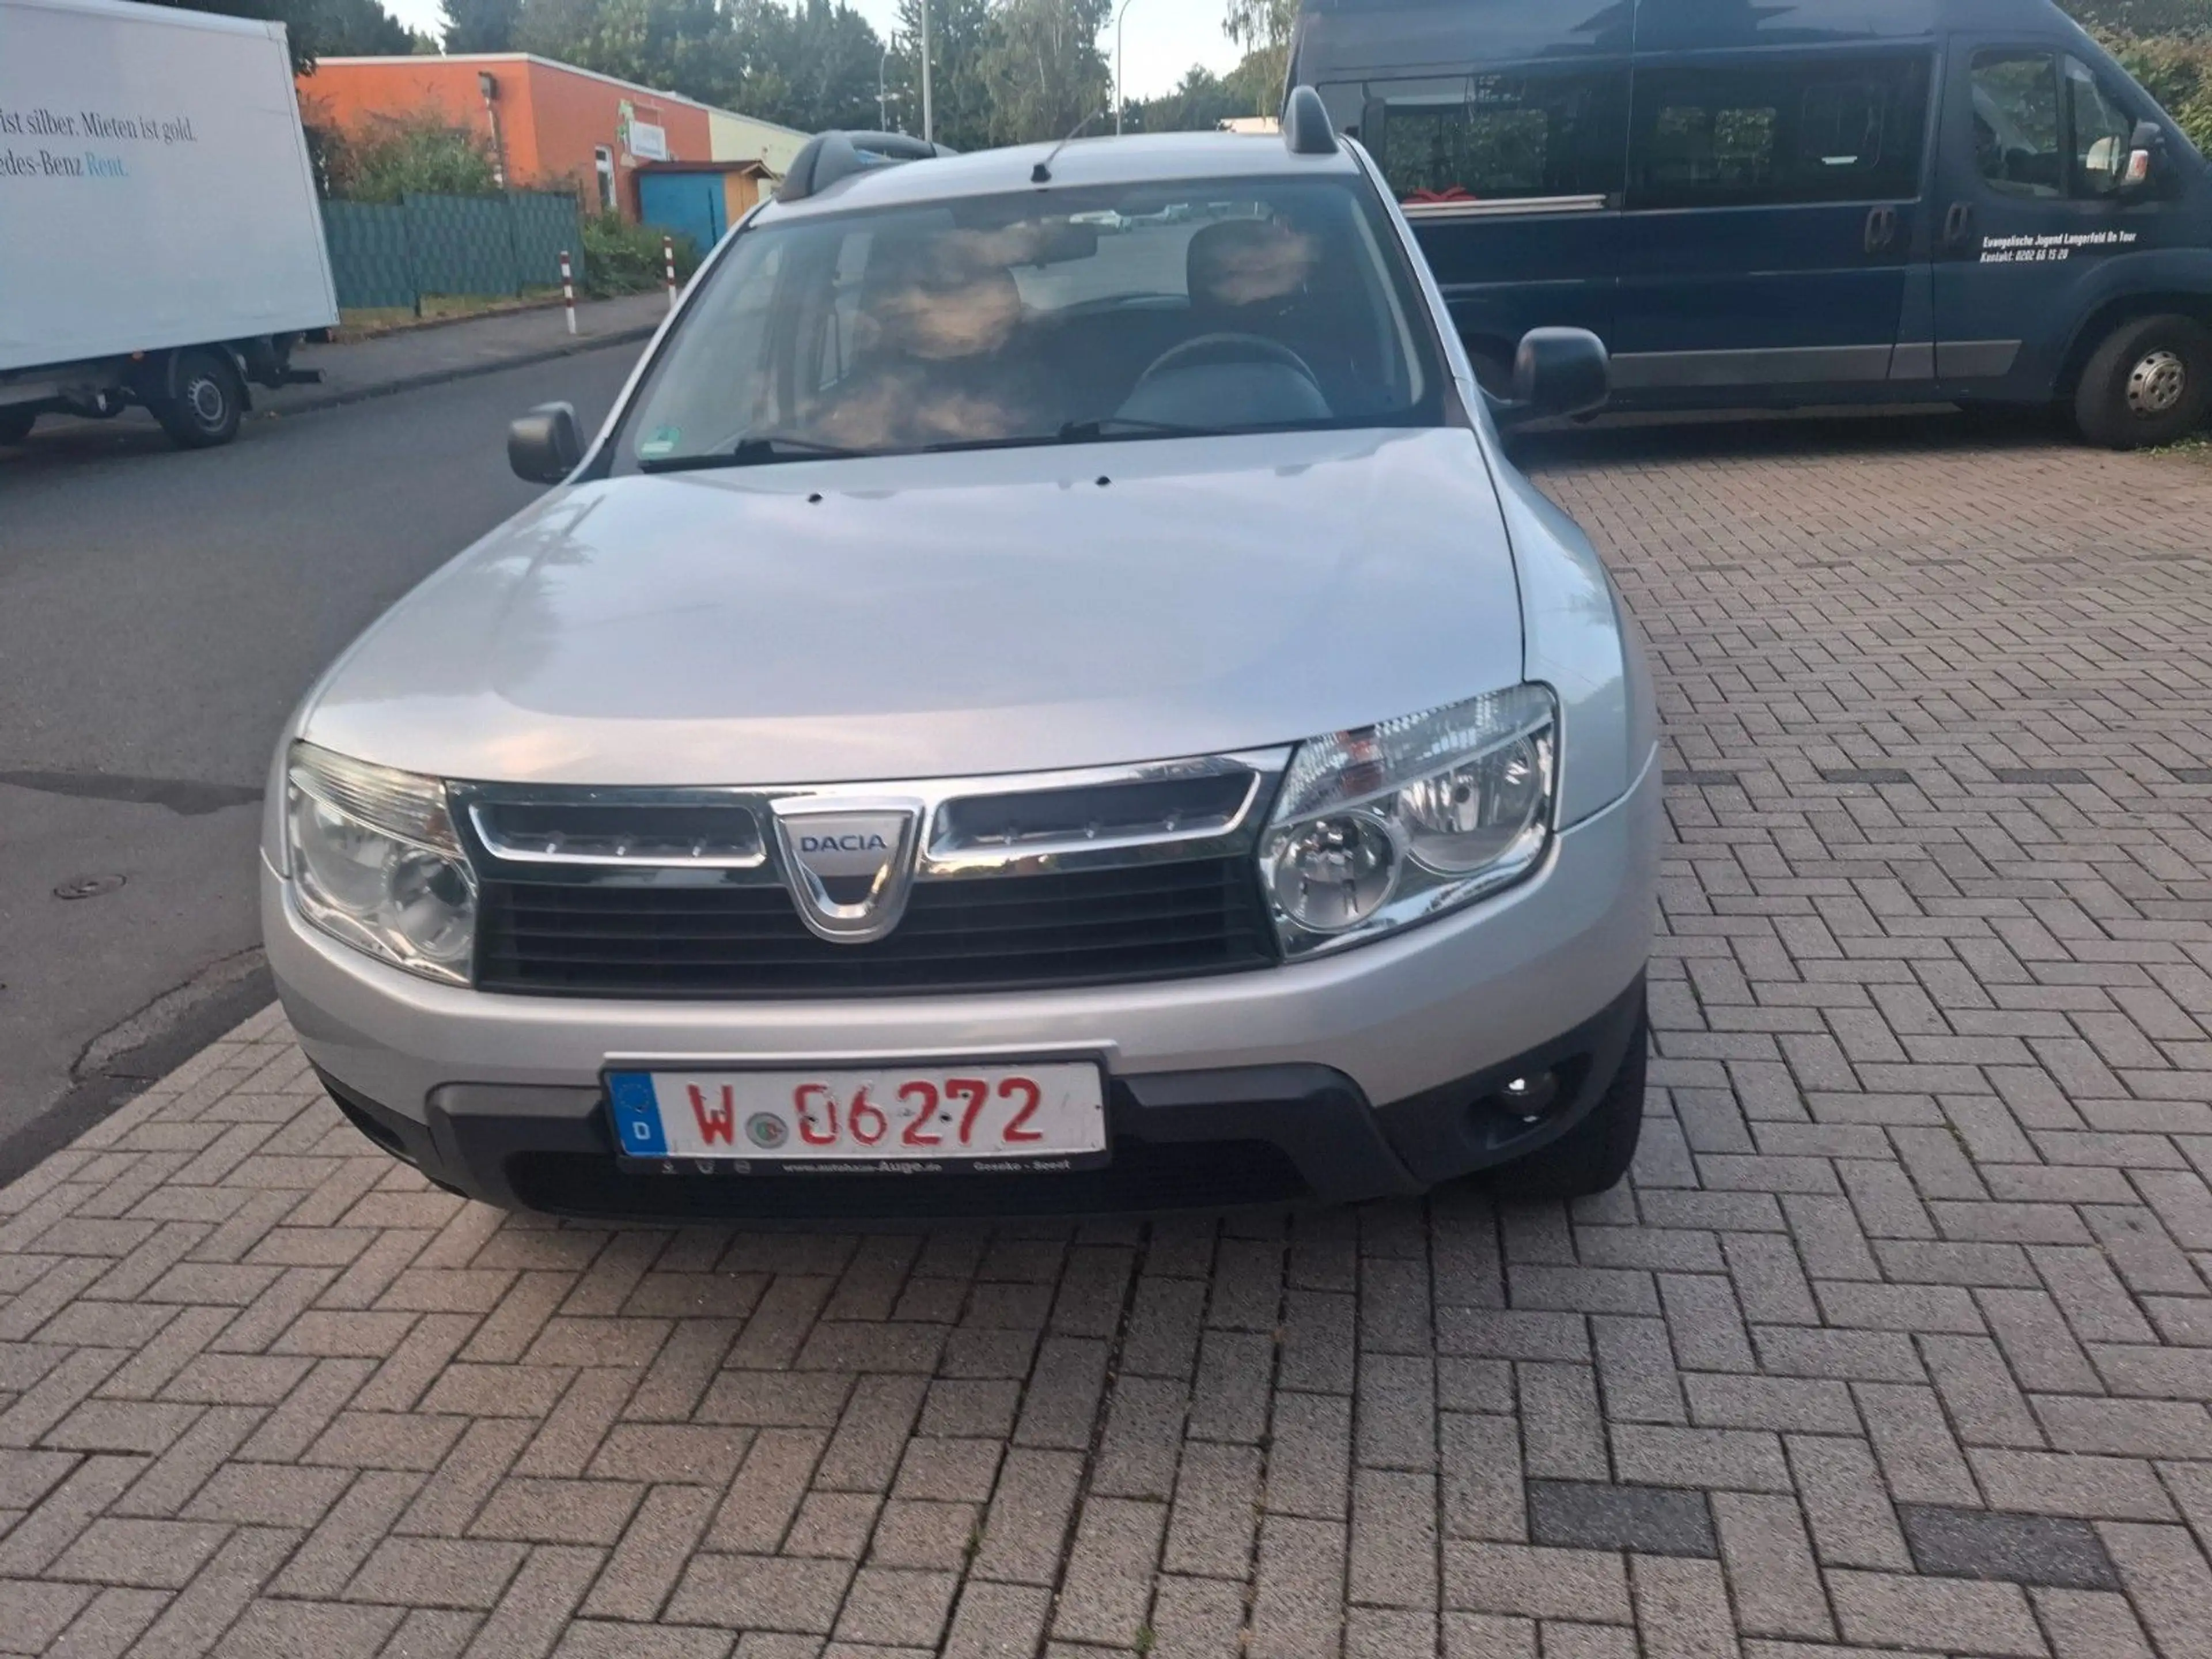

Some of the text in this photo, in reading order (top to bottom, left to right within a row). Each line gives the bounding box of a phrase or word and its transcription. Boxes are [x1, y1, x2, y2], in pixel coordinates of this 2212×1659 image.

[0, 108, 198, 145] ist silber. Mieten ist gold.
[85, 151, 130, 178] Rent.
[2035, 233, 2063, 247] Jugend
[800, 834, 888, 852] DACIA
[686, 1077, 1045, 1147] W 06272
[632, 1120, 652, 1140] D
